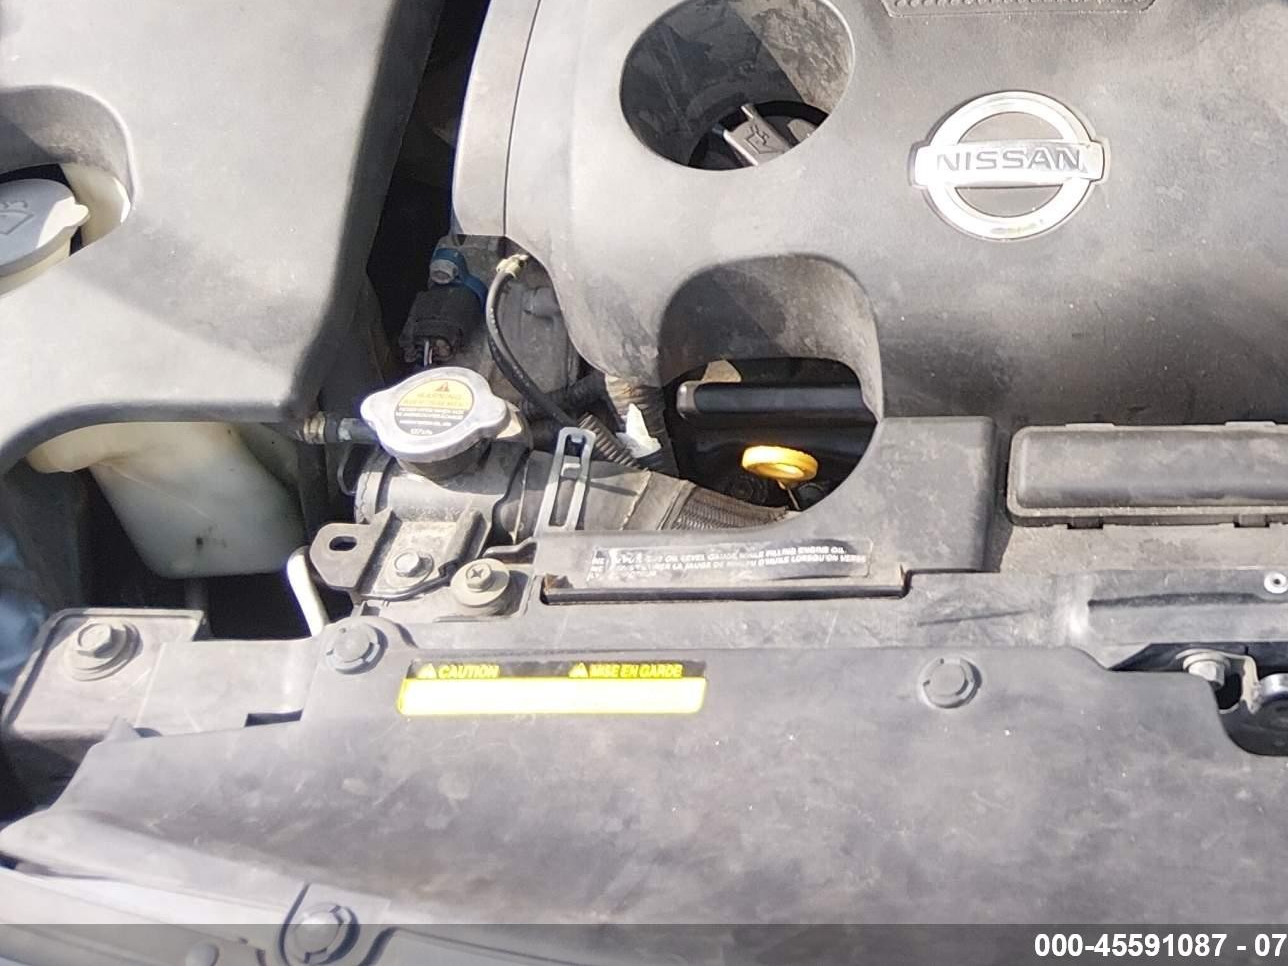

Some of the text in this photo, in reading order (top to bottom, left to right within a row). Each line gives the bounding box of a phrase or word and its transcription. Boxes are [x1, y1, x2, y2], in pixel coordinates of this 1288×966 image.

[936, 147, 1081, 174] NISSAN
[438, 664, 499, 678] CAUTION
[590, 664, 683, 678] MISE EN GARDE
